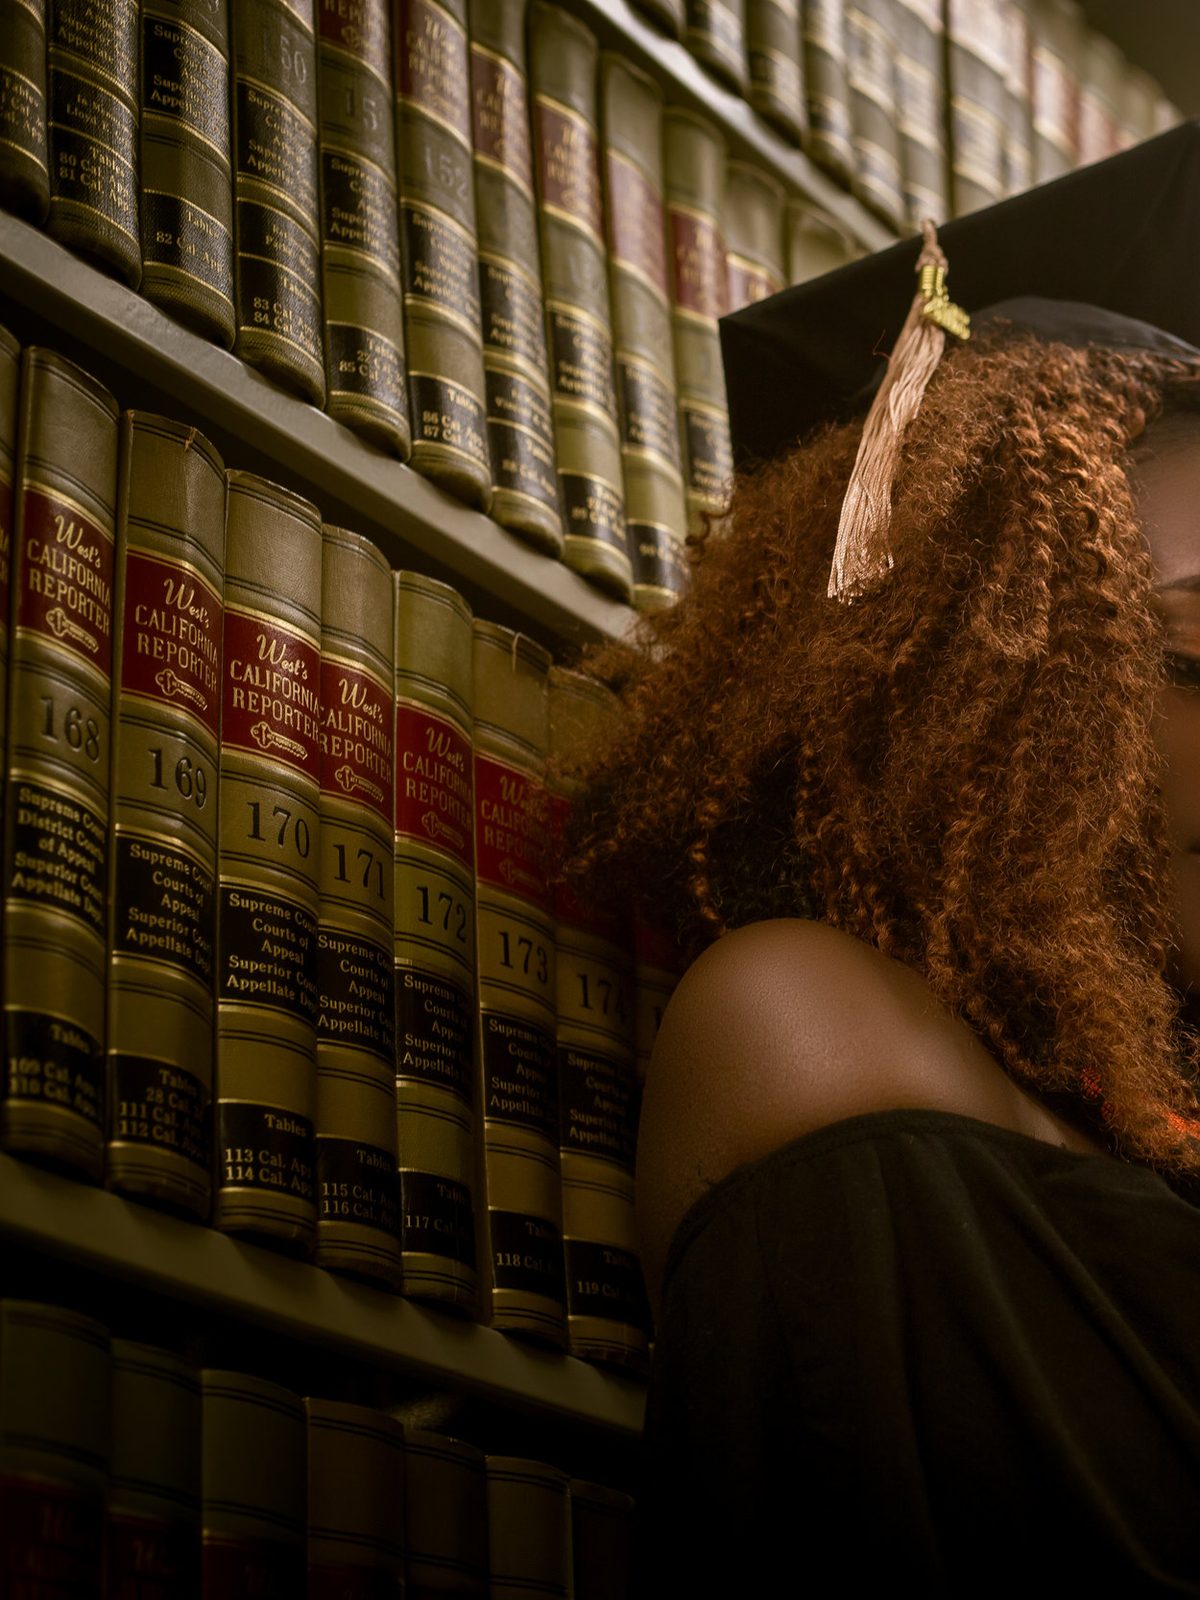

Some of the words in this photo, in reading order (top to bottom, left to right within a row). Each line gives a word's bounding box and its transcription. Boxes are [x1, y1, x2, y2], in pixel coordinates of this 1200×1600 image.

[156, 232, 173, 245] 82
[253, 298, 270, 310] 83
[253, 311, 270, 324] 84
[54, 514, 101, 569] West's
[27, 538, 112, 610] CALIFORNIA
[28, 567, 110, 637] REPORTER
[163, 577, 209, 629] West's
[135, 603, 218, 670] CALIFORNIA
[136, 631, 217, 693] REPORTER
[256, 633, 308, 680] West's
[230, 659, 320, 719] CALIFORNIA
[338, 678, 383, 724] West's
[40, 697, 101, 763] 168
[232, 686, 320, 744] REPORTER
[426, 726, 464, 772] West's
[148, 748, 207, 809] 169
[403, 751, 472, 800] CALIFORNIA
[19, 787, 80, 823] Supreme
[406, 777, 472, 831] REPORTER
[17, 808, 74, 841] District
[246, 801, 310, 859] 170
[38, 837, 55, 852] of
[129, 843, 190, 875] Supreme
[14, 851, 78, 884] Superior
[333, 844, 386, 901] 171
[11, 871, 81, 907] Appellate
[152, 870, 194, 899] Courts
[128, 906, 190, 937] Superior
[160, 893, 200, 921] Appeal
[228, 892, 292, 921] Supreme
[416, 886, 467, 944] 172
[126, 927, 192, 959] Appellate
[252, 917, 296, 943] Courts
[299, 935, 309, 950] of
[318, 935, 375, 960] Supreme
[228, 954, 292, 980] Superior
[261, 938, 304, 966] Appeal
[498, 931, 548, 985] 173
[340, 959, 379, 984] Courts
[226, 973, 296, 1001] Appellate
[348, 980, 385, 1006] Appeal
[319, 994, 376, 1019] Superior
[317, 1013, 380, 1040] Appellate
[404, 1032, 458, 1060] Superior
[491, 1075, 541, 1100] Superior
[120, 1102, 147, 1119] 111
[264, 1113, 307, 1137] Tables
[120, 1119, 148, 1137] 112
[225, 1148, 254, 1164] 113
[258, 1150, 287, 1169] Cal.
[225, 1166, 255, 1181] 114
[258, 1168, 287, 1187] Cal.
[322, 1182, 348, 1197] 115
[323, 1199, 350, 1215] 116
[405, 1215, 430, 1230] 117
[496, 1252, 521, 1267] 118
[577, 1280, 599, 1295] 119
